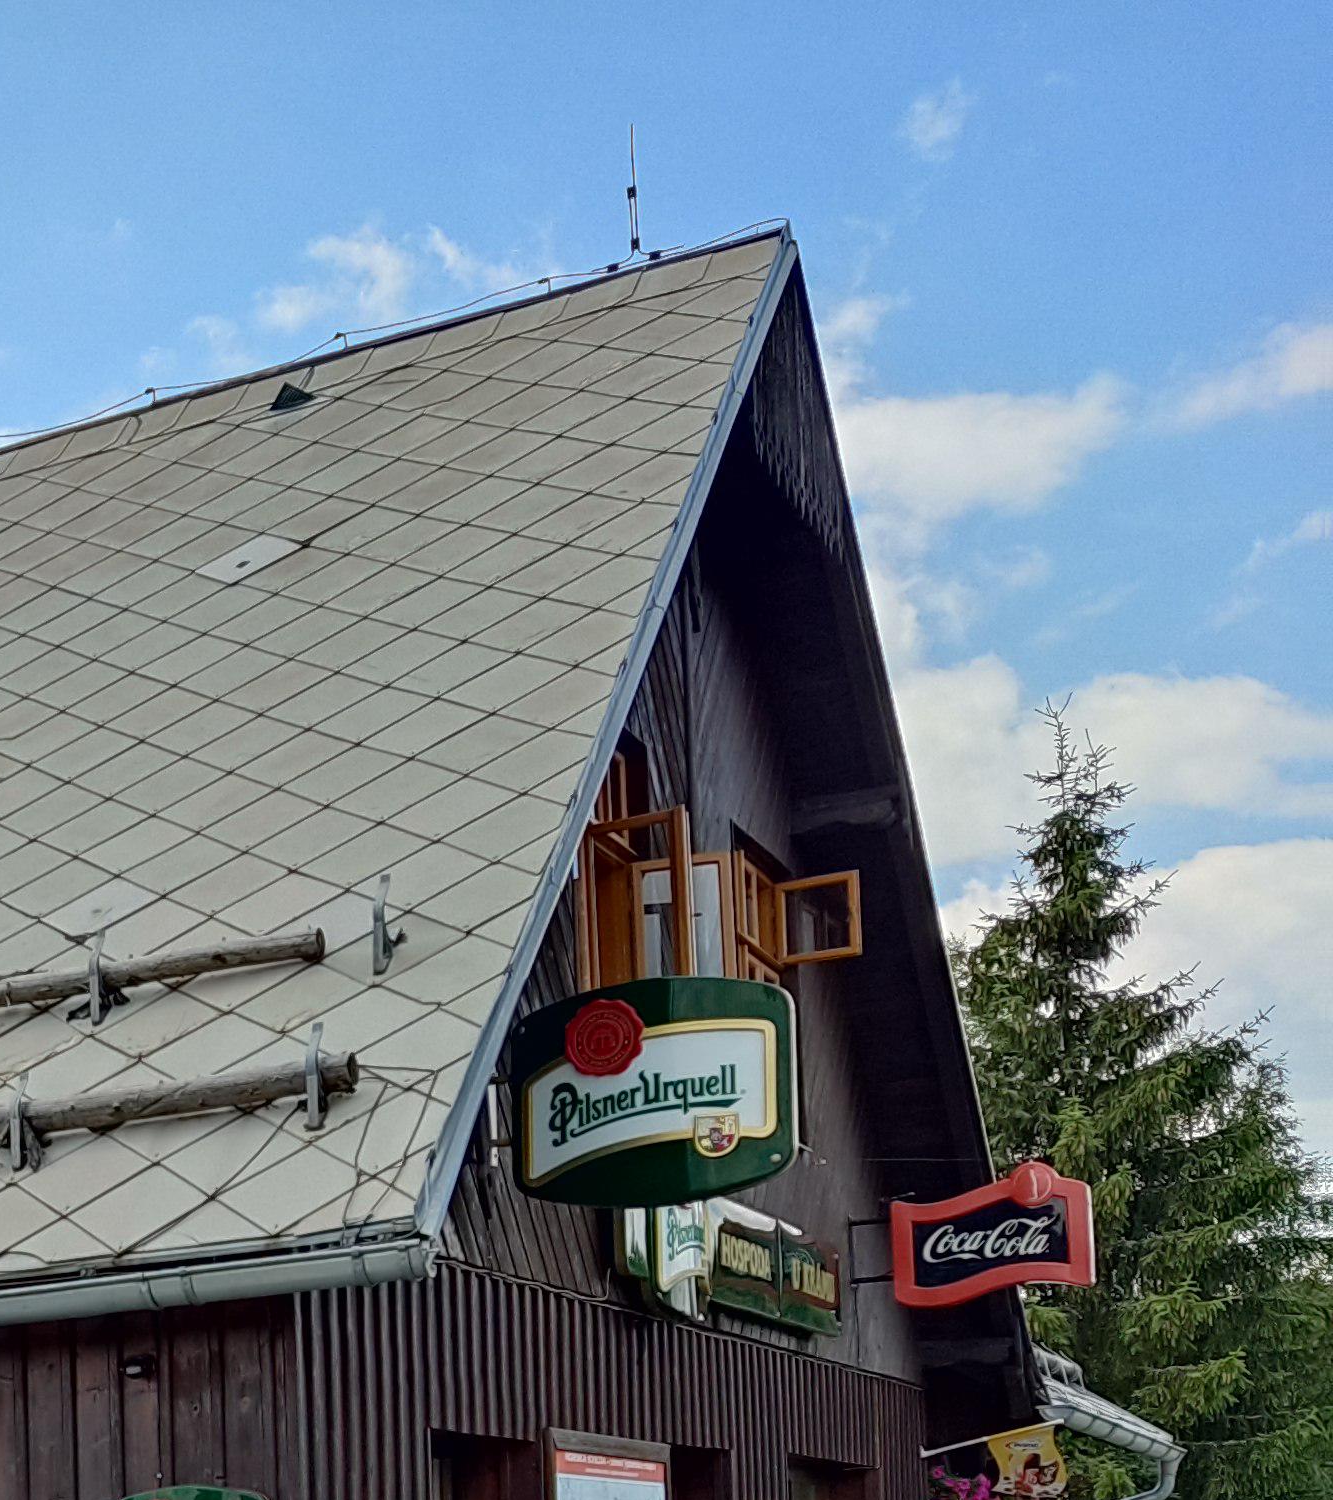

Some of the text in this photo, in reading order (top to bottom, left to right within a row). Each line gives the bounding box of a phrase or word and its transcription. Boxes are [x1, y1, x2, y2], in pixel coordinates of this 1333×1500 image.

[548, 1064, 738, 1147] Pilsner Urquell
[721, 1230, 772, 1282] HOSPODA
[923, 1215, 1056, 1263] Coca-Cola
